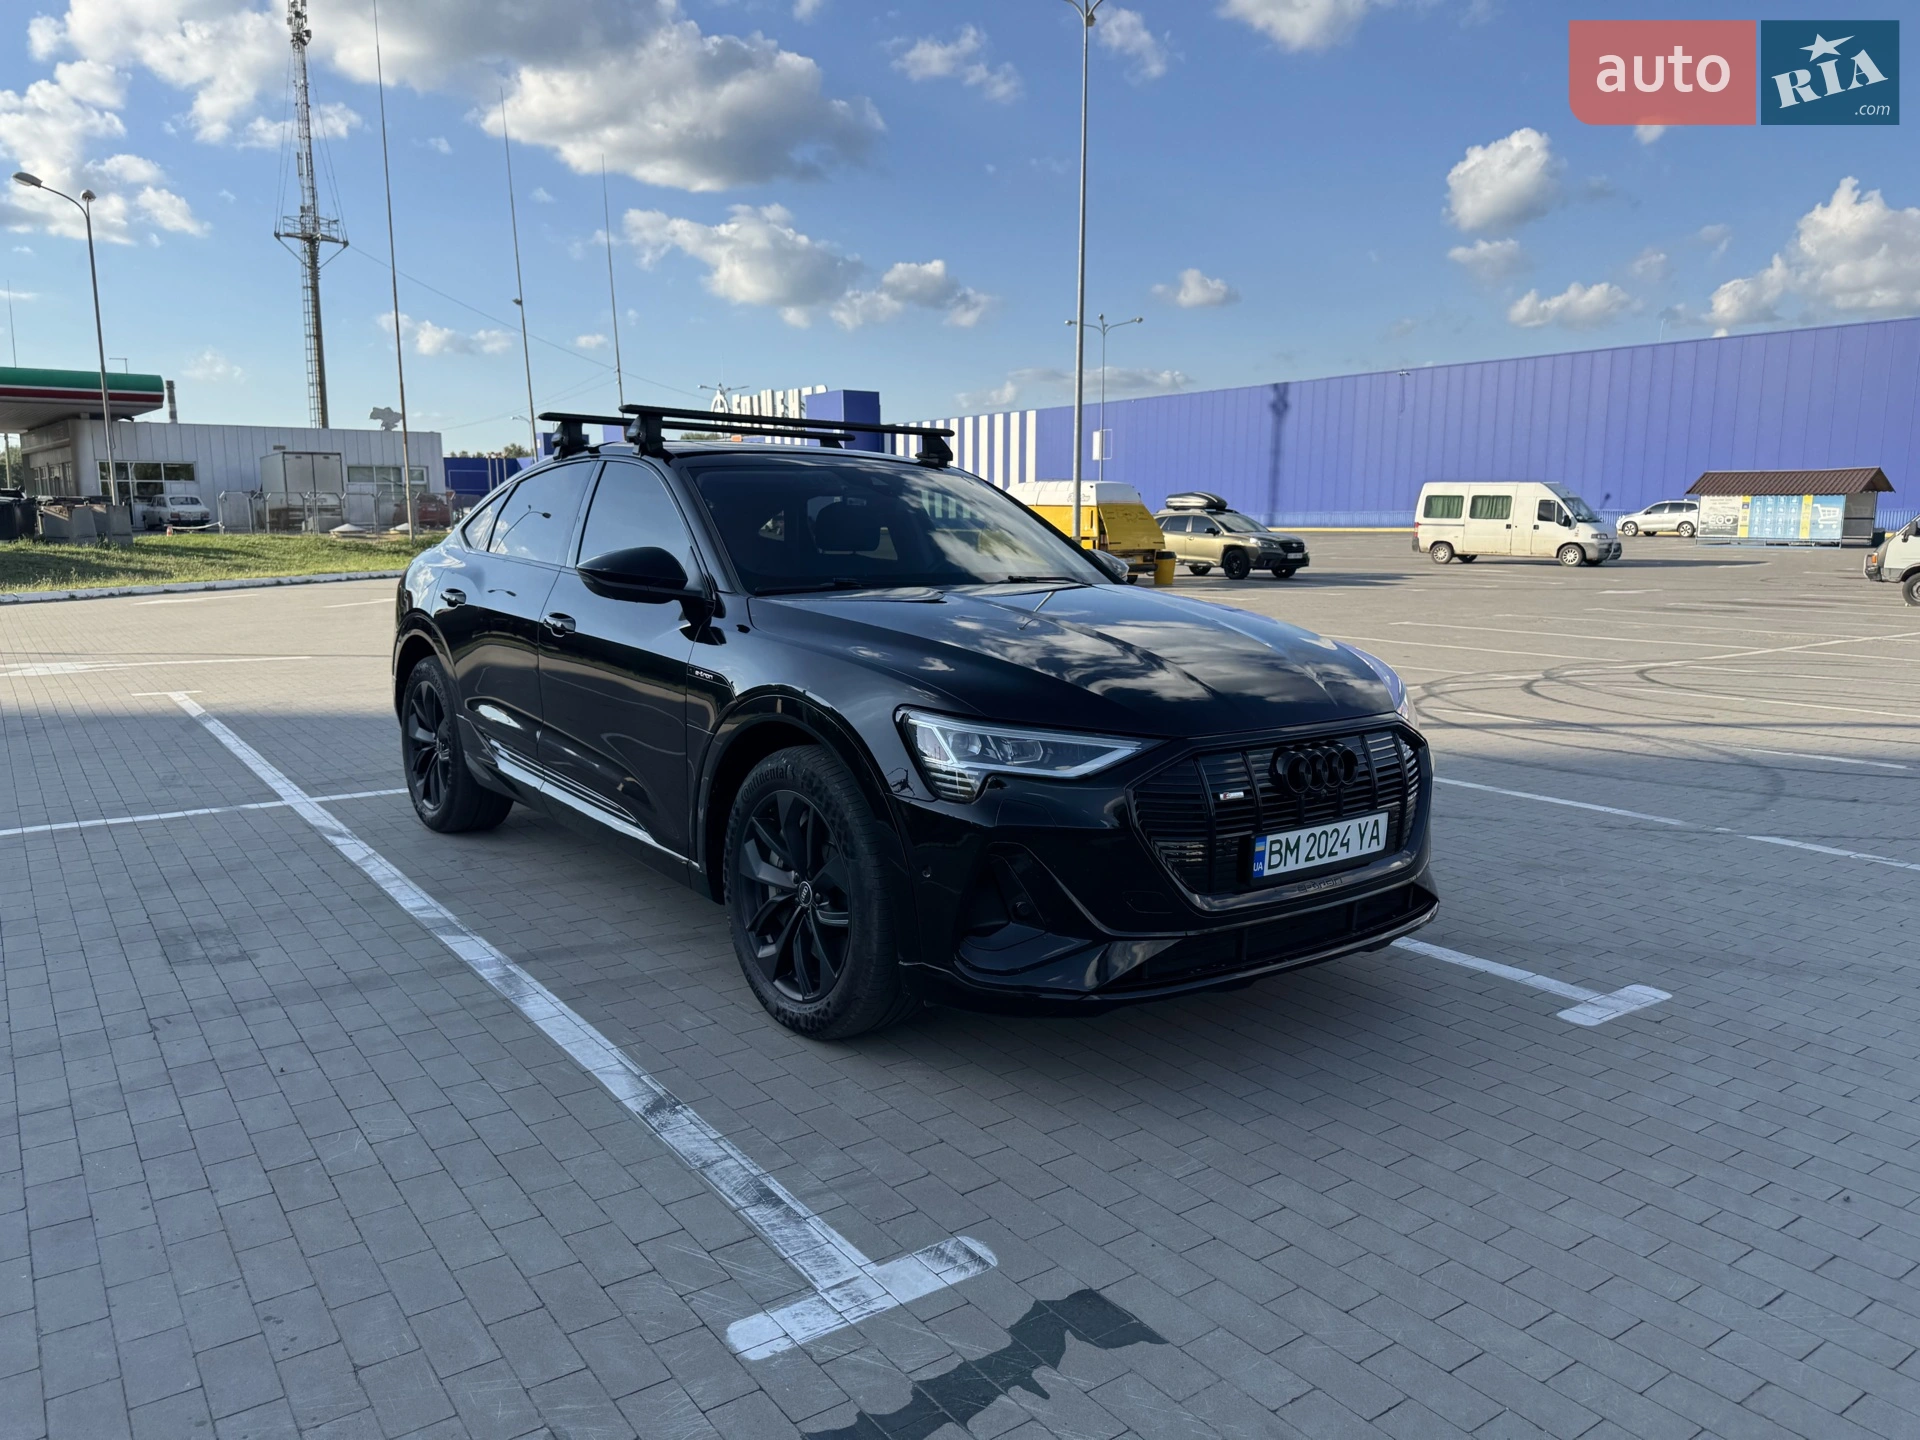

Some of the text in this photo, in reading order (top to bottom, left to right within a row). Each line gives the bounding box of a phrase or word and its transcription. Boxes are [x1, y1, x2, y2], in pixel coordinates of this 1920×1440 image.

[695, 670, 714, 680] e-tron
[742, 765, 788, 802] Continental
[1253, 819, 1380, 872] UA BM 2024 YA
